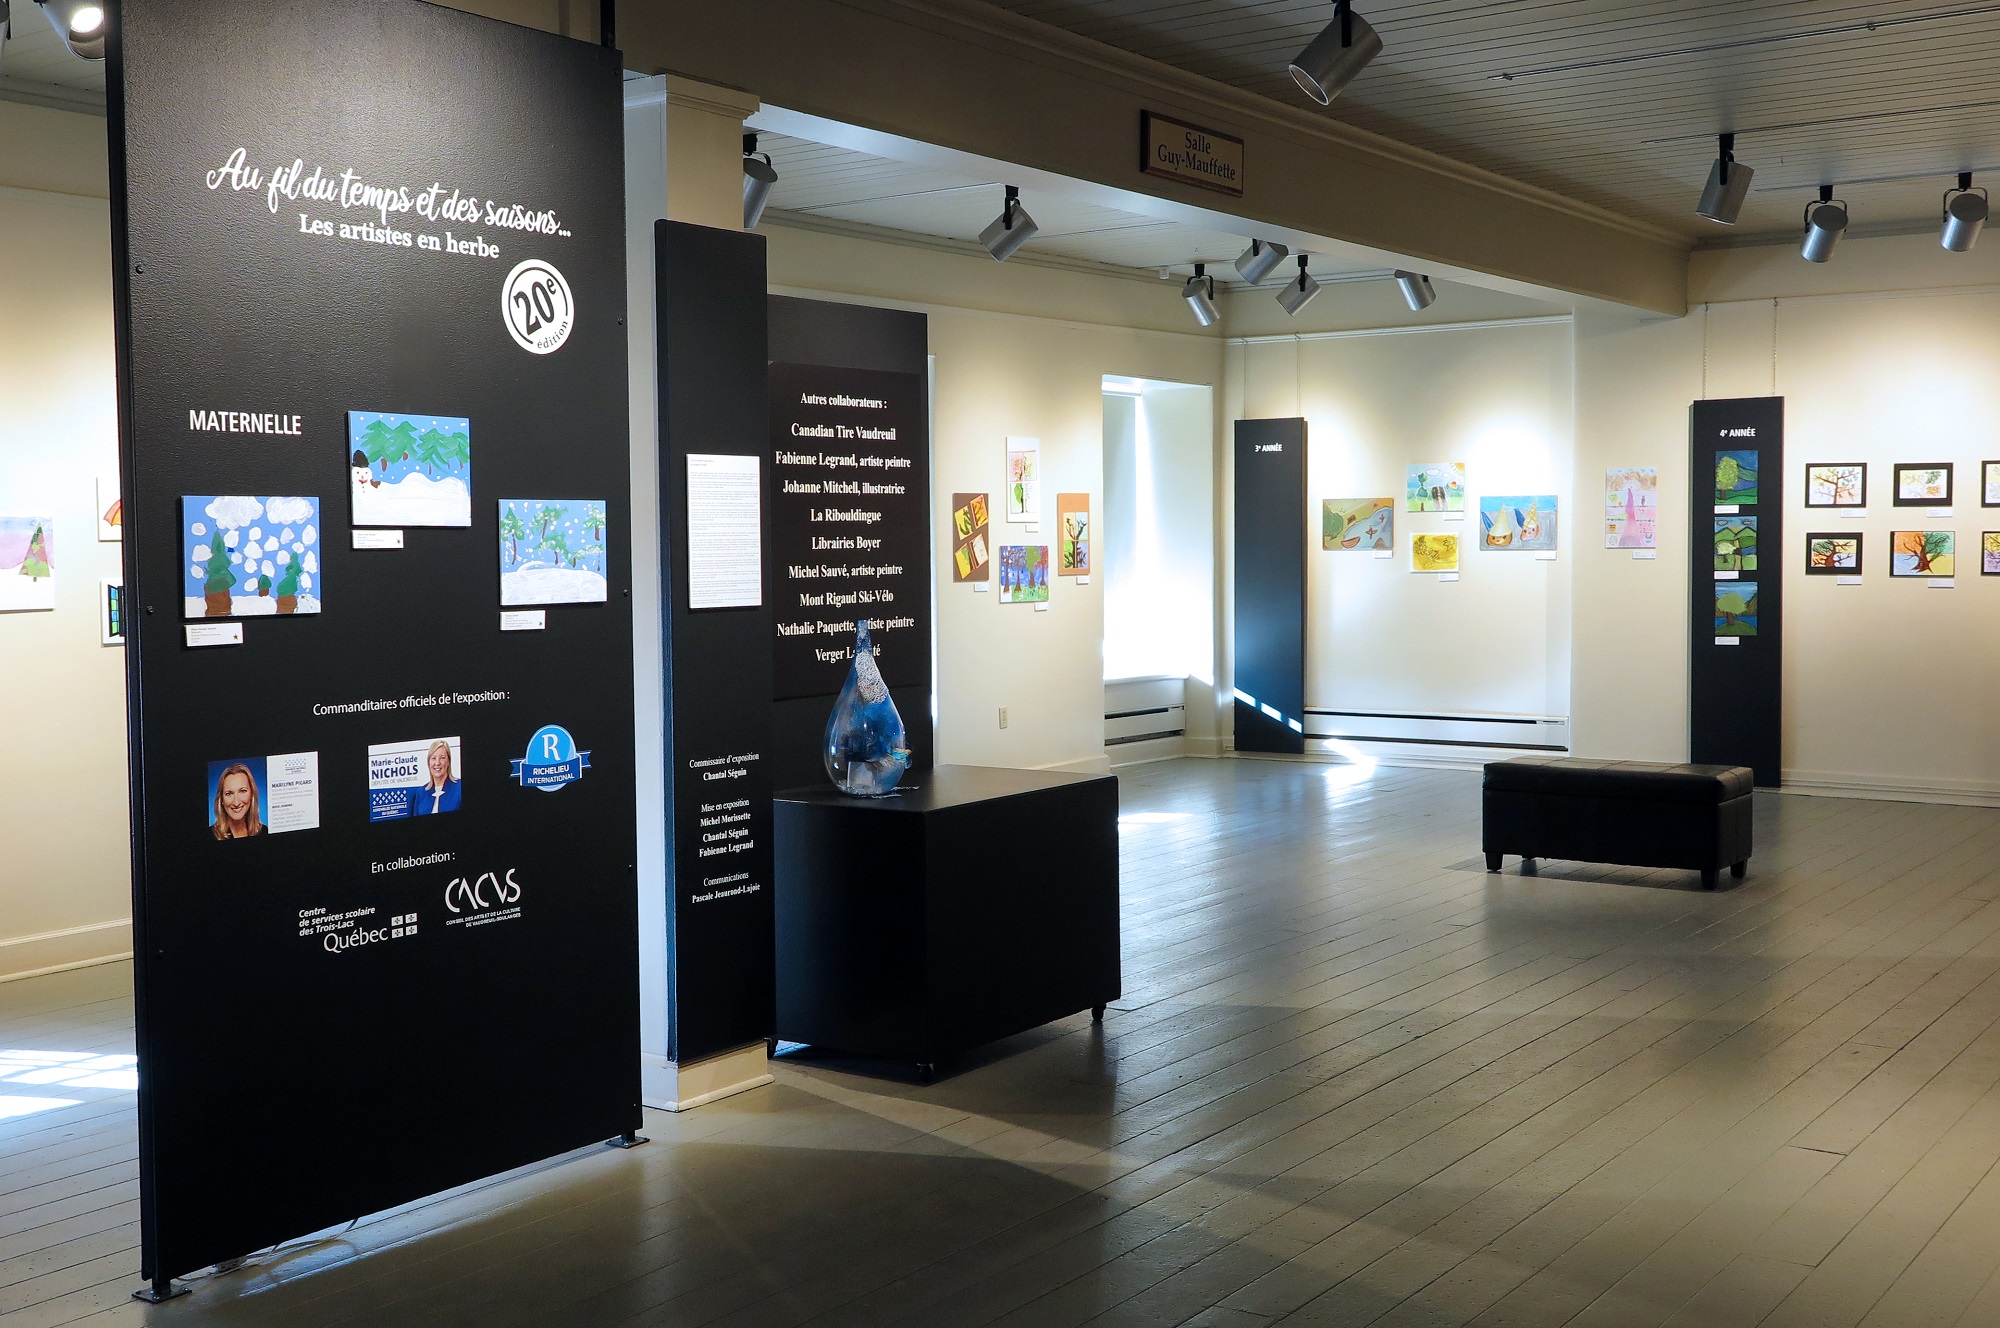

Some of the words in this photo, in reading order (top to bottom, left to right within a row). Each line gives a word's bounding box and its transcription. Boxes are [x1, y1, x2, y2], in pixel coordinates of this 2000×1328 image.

[1185, 132, 1211, 154] Salle
[1158, 144, 1236, 181] Guy-Mauffette
[206, 147, 263, 190] Au
[268, 158, 303, 213] fil
[302, 166, 338, 201] du
[337, 168, 414, 224] temps
[416, 182, 449, 221] et
[442, 189, 484, 224] des
[300, 214, 333, 237] Les
[340, 222, 412, 248] artistes
[417, 234, 441, 251] en
[446, 232, 499, 259] herbe
[537, 320, 568, 349] édition
[800, 392, 827, 406] Autres
[828, 394, 883, 409] collaborateurs
[189, 409, 301, 435] MATERNELLE
[791, 422, 834, 438] Canadian
[836, 425, 854, 439] Tire
[855, 426, 896, 441] Vaudreuil
[1729, 427, 1756, 437] ANNÉE
[1262, 443, 1282, 452] ANNÉE
[775, 451, 817, 465] Fabienne
[819, 453, 858, 469] Legrand,
[859, 455, 883, 468] artiste
[885, 456, 911, 470] peintre
[783, 480, 821, 493] Johanne
[823, 481, 861, 496] Mitchell,
[862, 482, 905, 495] illustratrice
[810, 509, 823, 521] La
[825, 508, 882, 525] Ribouldingue
[812, 536, 854, 550] Librairies
[856, 536, 881, 551] Boyer
[788, 565, 819, 578] Michel
[821, 564, 850, 579] Sauvé,
[851, 565, 875, 577] artiste
[876, 564, 903, 578] peintre
[800, 592, 824, 607] Mont
[826, 591, 857, 608] Rigaud
[858, 589, 894, 604] Ski-Vélo
[777, 621, 815, 637] Nathalie
[817, 619, 857, 635] Paquette,
[886, 617, 914, 631] peintre
[815, 648, 845, 664] Verger
[313, 698, 398, 716] Commanditaires
[400, 694, 437, 709] officiels
[438, 693, 451, 705] de
[452, 690, 505, 705] l'exposition
[541, 733, 561, 761] R
[371, 755, 417, 767] Marie-Claude
[689, 754, 726, 769] Commissaire
[726, 751, 760, 765] d'exposition
[371, 764, 418, 780] NICHOLS
[527, 772, 575, 784] INTERNATIONAL
[533, 764, 570, 775] RICHELIEU
[703, 769, 727, 781] Chantal
[727, 767, 747, 779] Séguin
[701, 802, 715, 813] Mise
[723, 798, 750, 811] exposition
[700, 815, 720, 827] Michel
[721, 812, 751, 825] Morissette
[702, 830, 727, 843] Chantal
[728, 828, 749, 841] Séguin
[699, 843, 727, 857] Fabienne
[728, 840, 754, 853] Legrand
[371, 861, 384, 874] En
[386, 852, 450, 871] collaboration
[703, 871, 749, 887] Communications
[692, 889, 714, 903] Pascale
[299, 907, 327, 918] Centre
[299, 918, 310, 928] de
[311, 913, 344, 925] services
[345, 906, 376, 919] scolaire
[299, 927, 314, 937] des
[316, 920, 355, 934] Trois-Lacs
[323, 927, 389, 954] Québec
